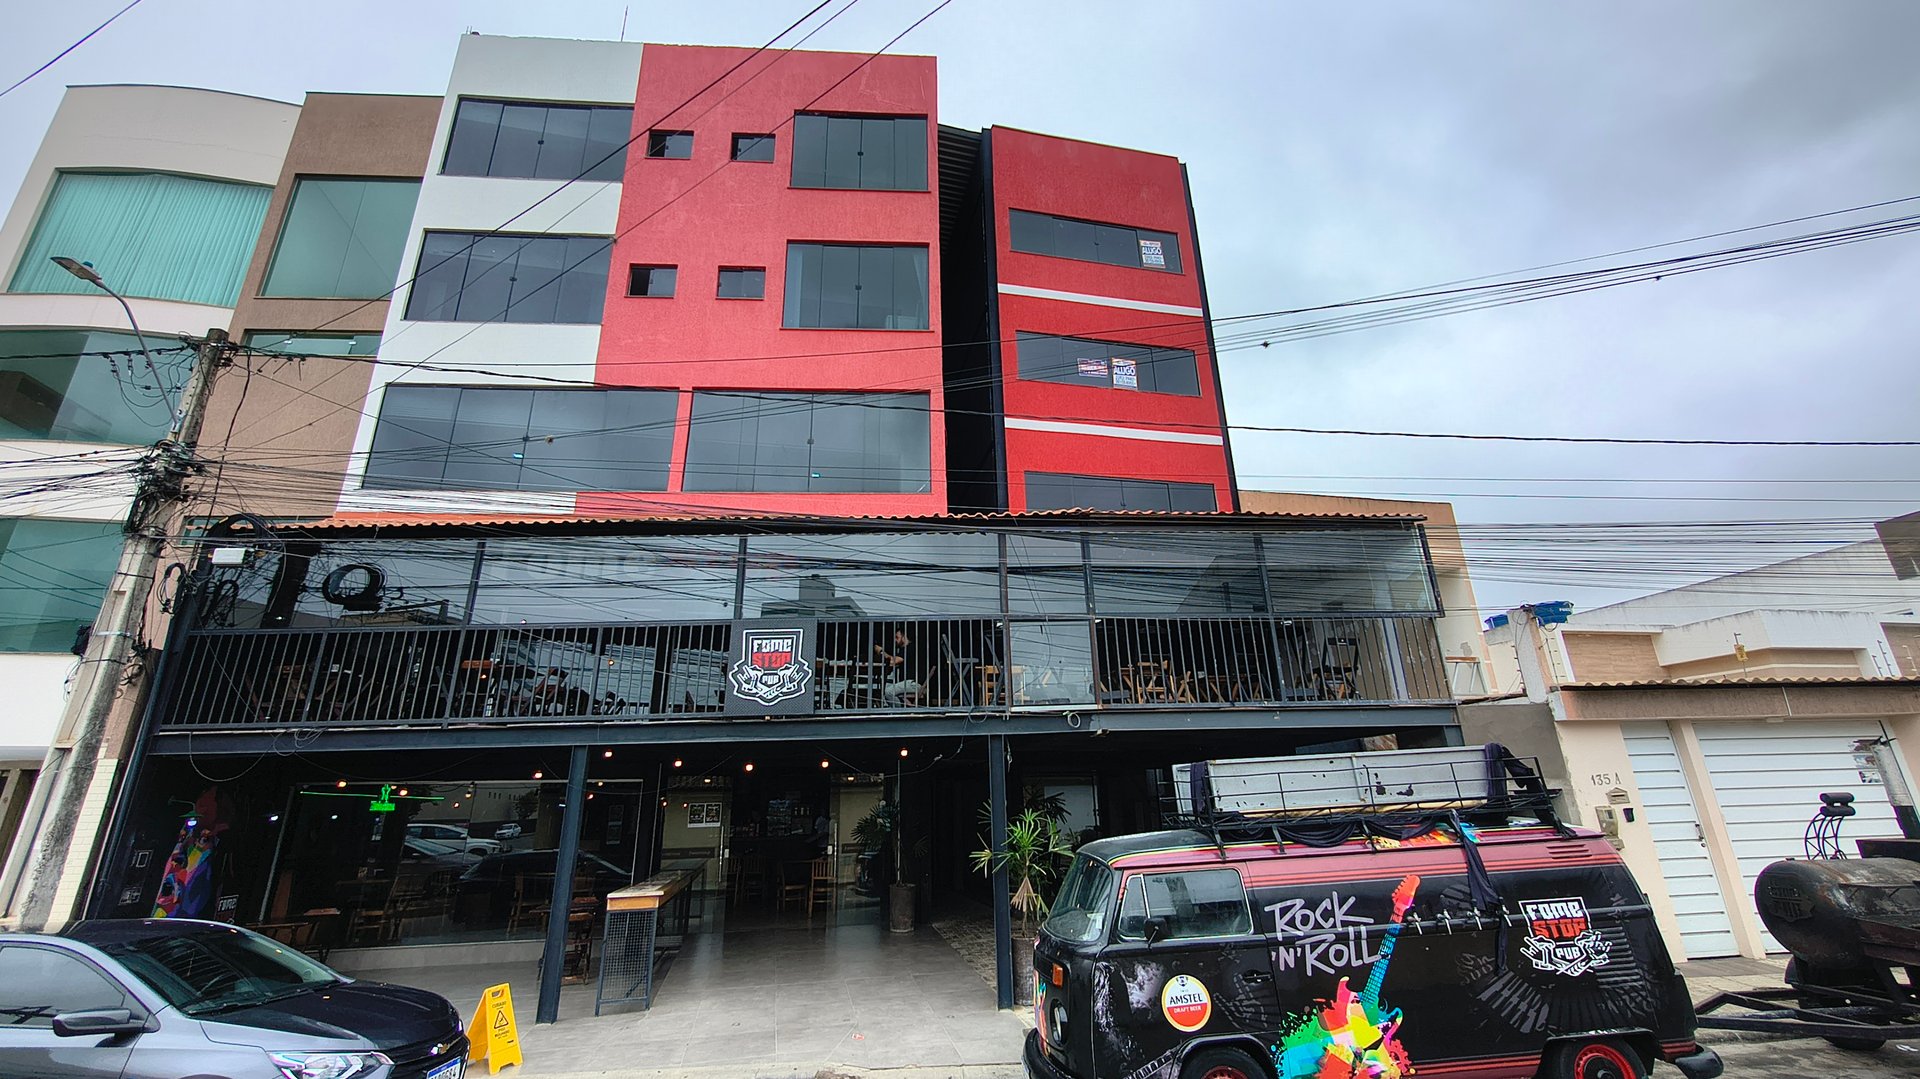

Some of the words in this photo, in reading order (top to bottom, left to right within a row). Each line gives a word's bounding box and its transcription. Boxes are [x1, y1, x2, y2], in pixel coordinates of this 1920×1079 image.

[1113, 365, 1136, 375] ALUGO
[753, 639, 792, 653] FOME
[752, 652, 791, 668] STOP
[762, 675, 779, 685] PUB
[1591, 773, 1611, 786] 135
[1615, 772, 1622, 785] A
[1264, 891, 1375, 941] ROCK
[1525, 901, 1584, 920] FOME
[1532, 917, 1587, 939] STOP
[1555, 946, 1581, 960] PUB
[1169, 993, 1203, 1005] AMSTEL
